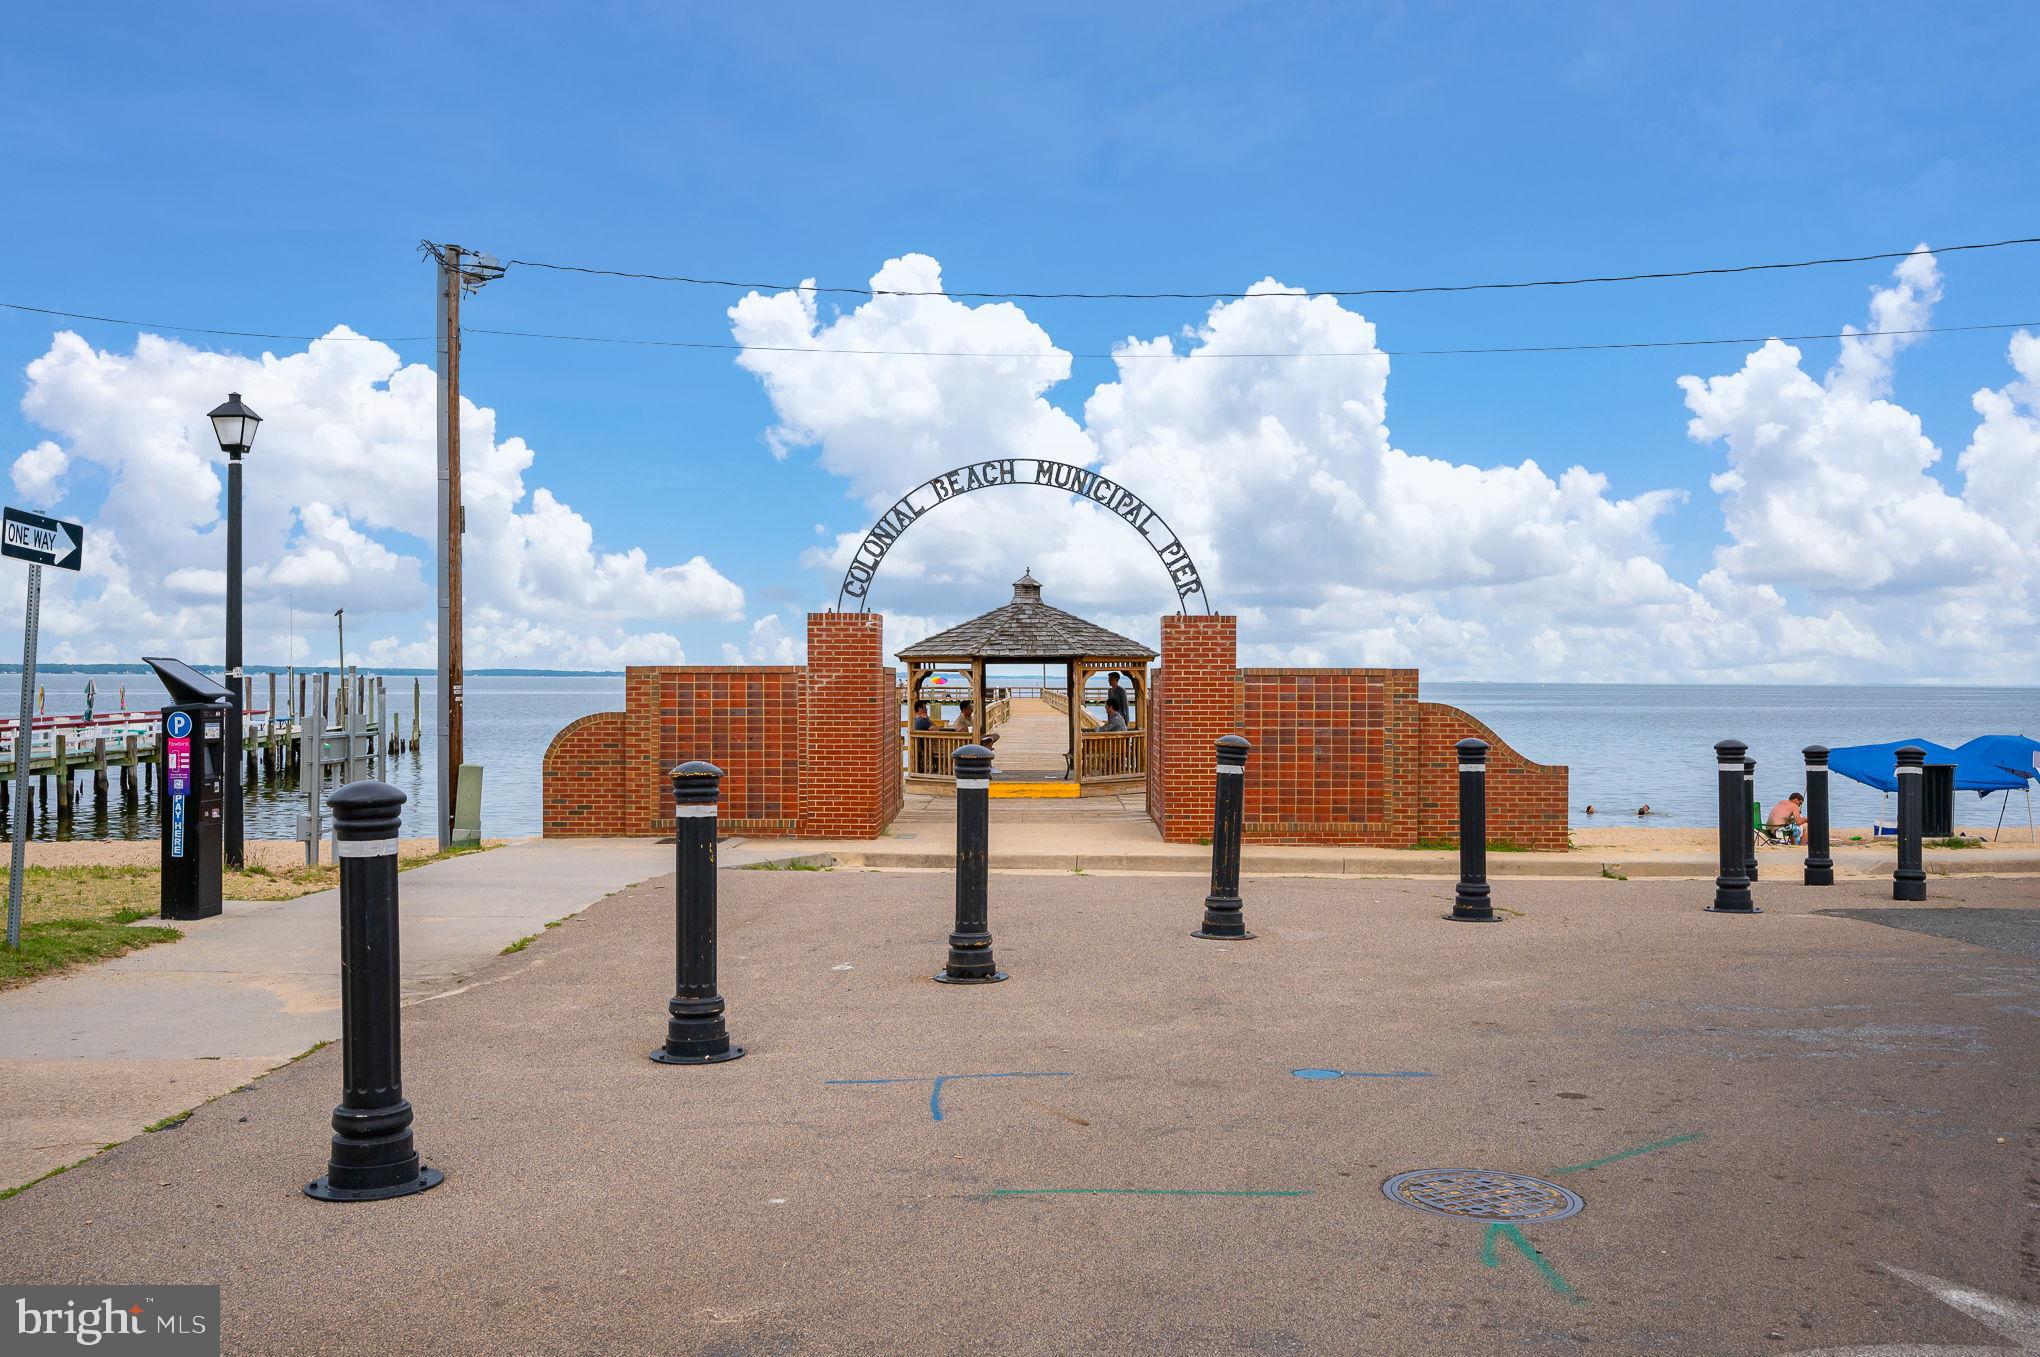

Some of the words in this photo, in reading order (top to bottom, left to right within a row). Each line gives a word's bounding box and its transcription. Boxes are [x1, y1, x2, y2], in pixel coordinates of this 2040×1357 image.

[8, 523, 30, 546] ONE
[33, 529, 57, 551] WAY
[844, 496, 926, 598] COLONIAL
[930, 459, 1016, 503] BEACH
[1034, 459, 1155, 536] MUNICIPAL
[1158, 538, 1201, 600] PIER
[174, 716, 186, 735] P
[175, 794, 183, 819] PAY
[174, 821, 182, 854] HERE
